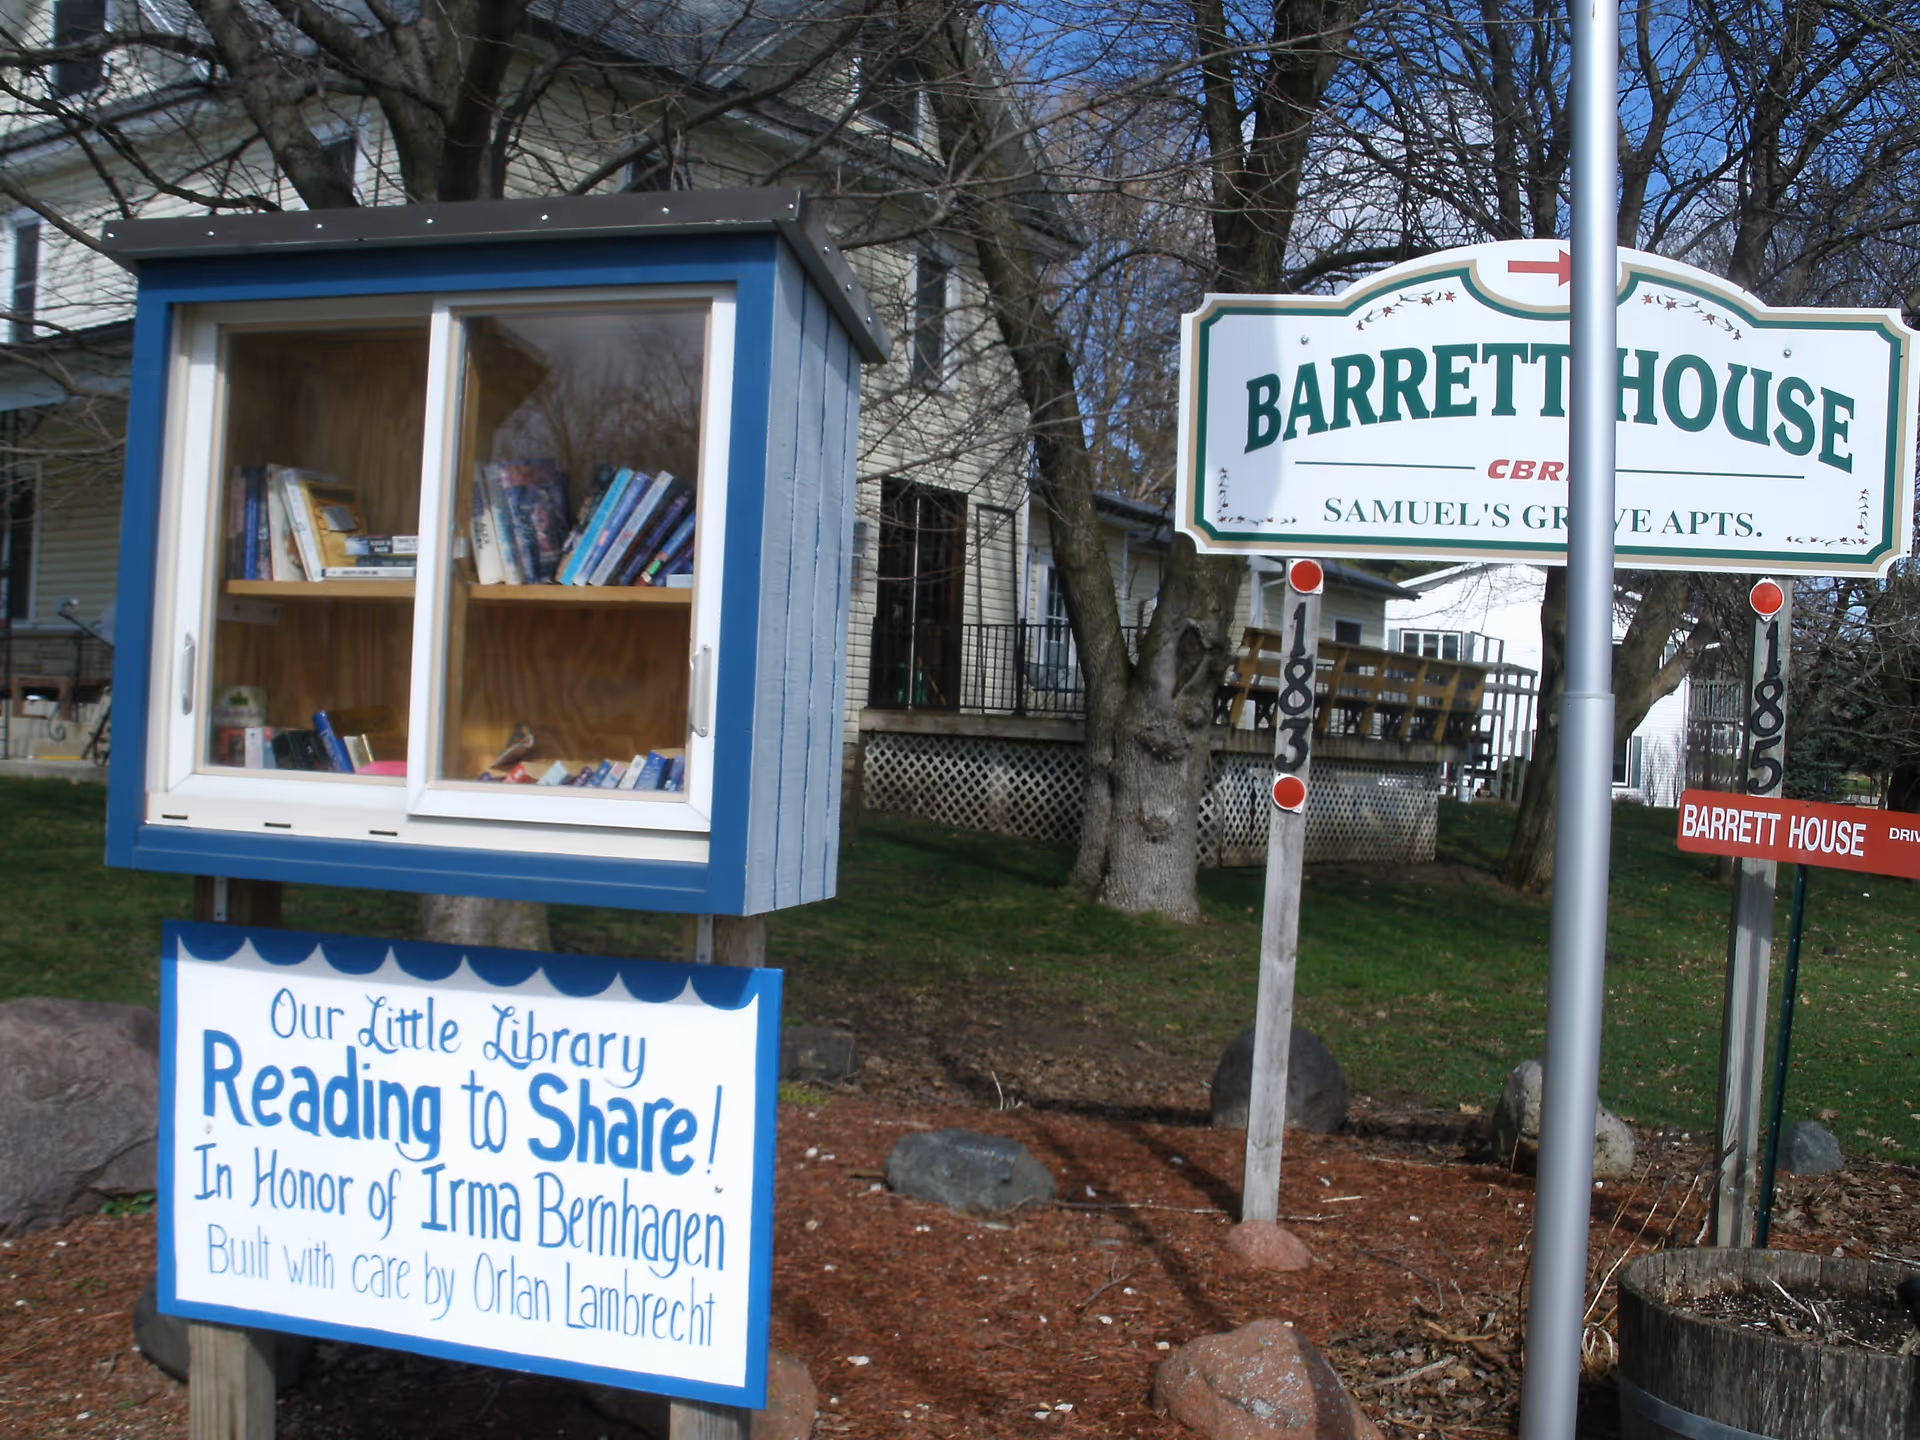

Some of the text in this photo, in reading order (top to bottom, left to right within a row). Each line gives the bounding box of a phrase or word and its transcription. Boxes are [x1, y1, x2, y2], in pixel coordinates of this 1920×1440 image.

[1244, 343, 1856, 475] BARRETT HOUSE
[1488, 459, 1570, 481] CBR
[1324, 497, 1763, 538] SAMUEL'S GRVE APTS.
[1272, 601, 1314, 773] 183
[1747, 621, 1785, 796] 185
[1682, 804, 1783, 847] BARRETT
[1788, 815, 1867, 857] HOUSE
[203, 1029, 723, 1176] Reading to Share!
[270, 988, 646, 1089] Our Little Library
[193, 1143, 725, 1279] In Honor of Irma Bernhagen
[208, 1223, 716, 1347] Built with care by Orlan Lambrecht
